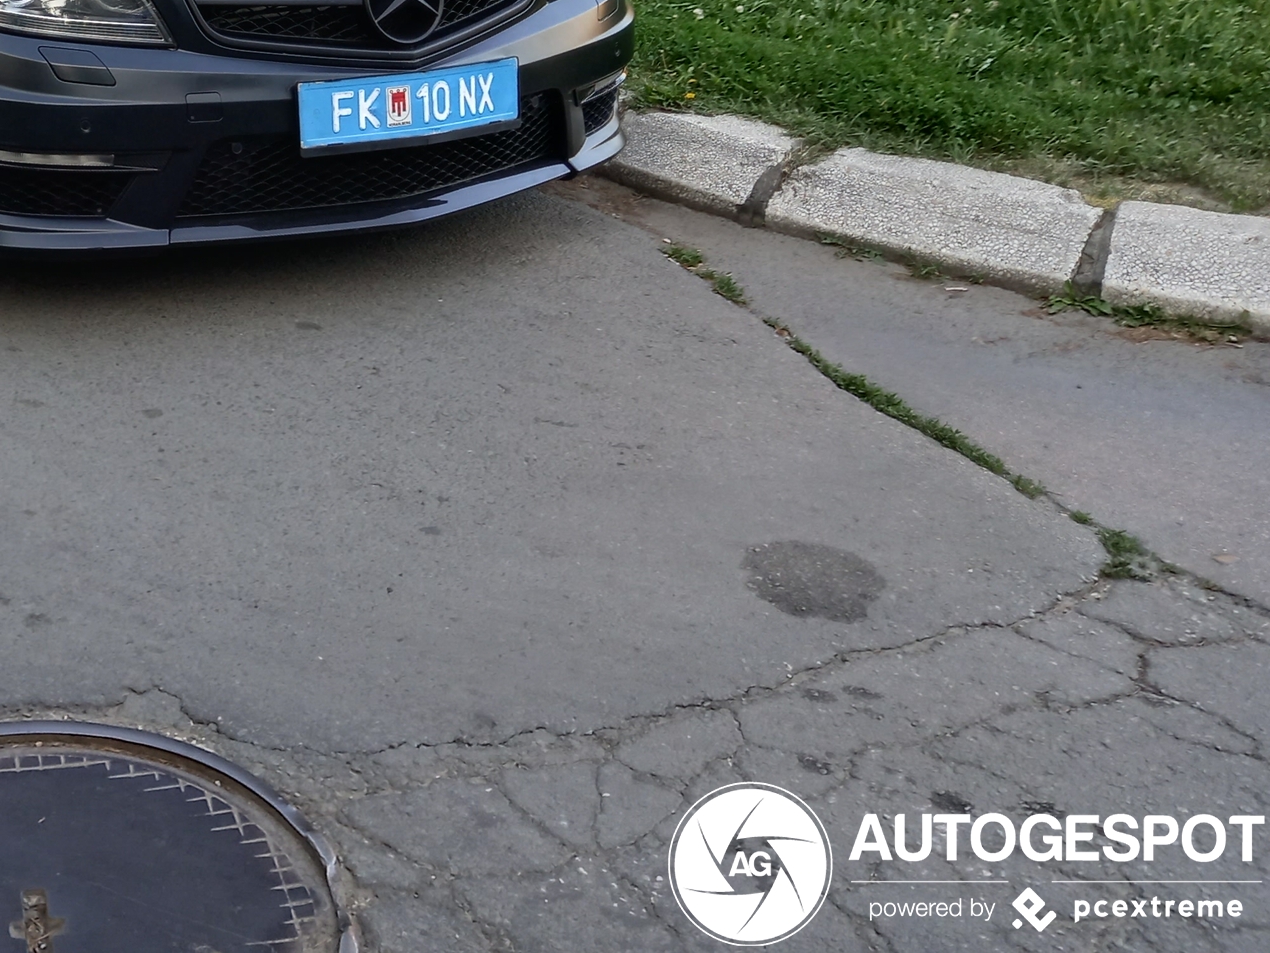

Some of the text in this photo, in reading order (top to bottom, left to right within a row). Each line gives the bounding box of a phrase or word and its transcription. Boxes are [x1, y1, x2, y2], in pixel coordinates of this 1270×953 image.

[331, 72, 495, 133] FK 10 NX
